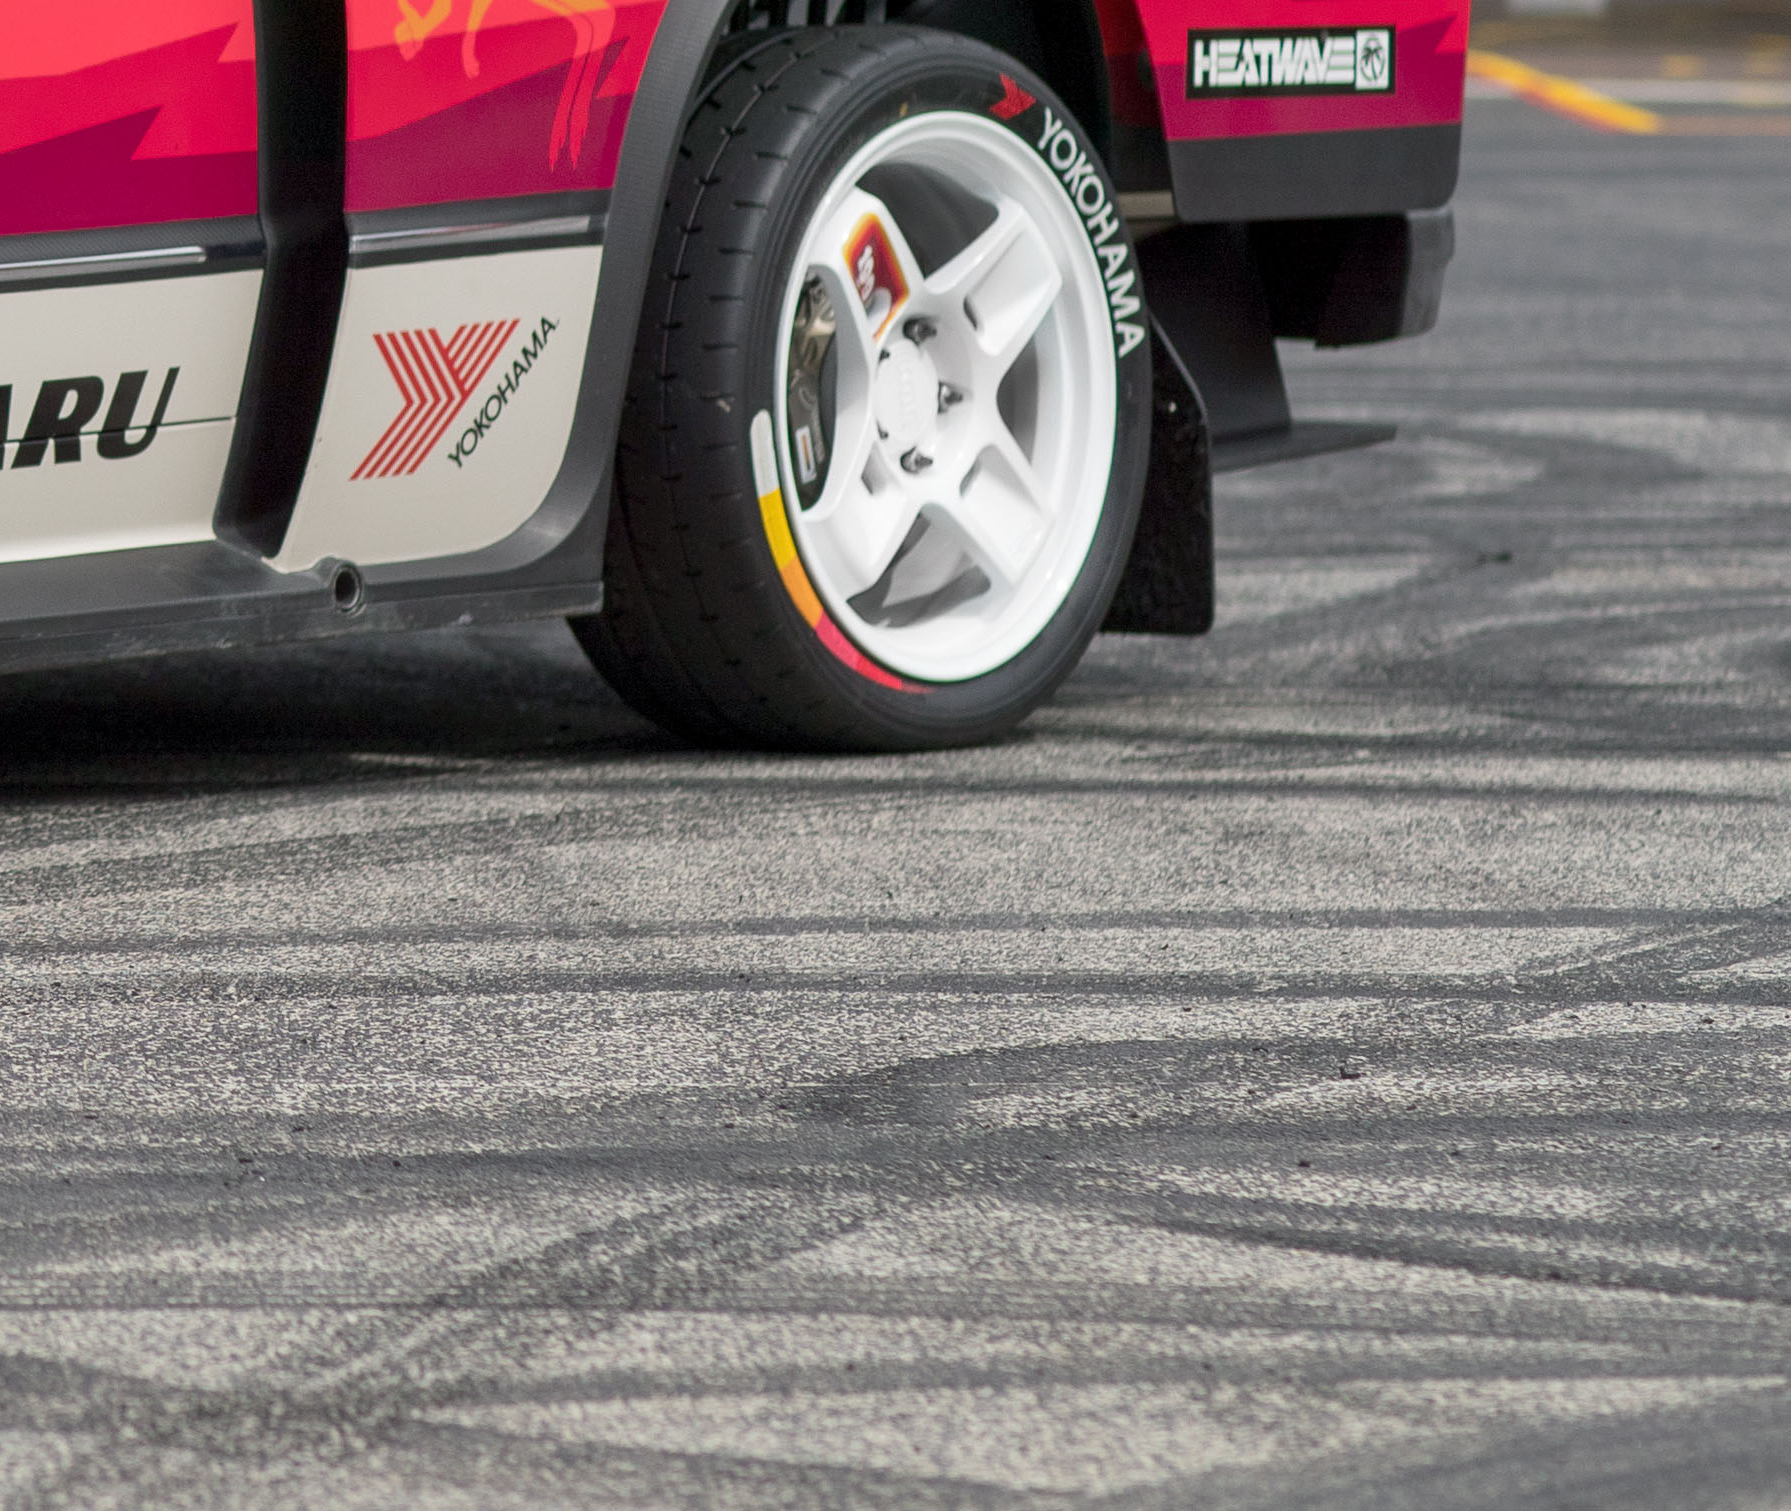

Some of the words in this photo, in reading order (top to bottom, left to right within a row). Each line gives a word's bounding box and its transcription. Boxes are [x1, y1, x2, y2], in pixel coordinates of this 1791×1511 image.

[1192, 36, 1356, 88] HEATWAVE
[1034, 106, 1147, 360] YOKOHAMA
[447, 315, 557, 470] YOKOHAMA
